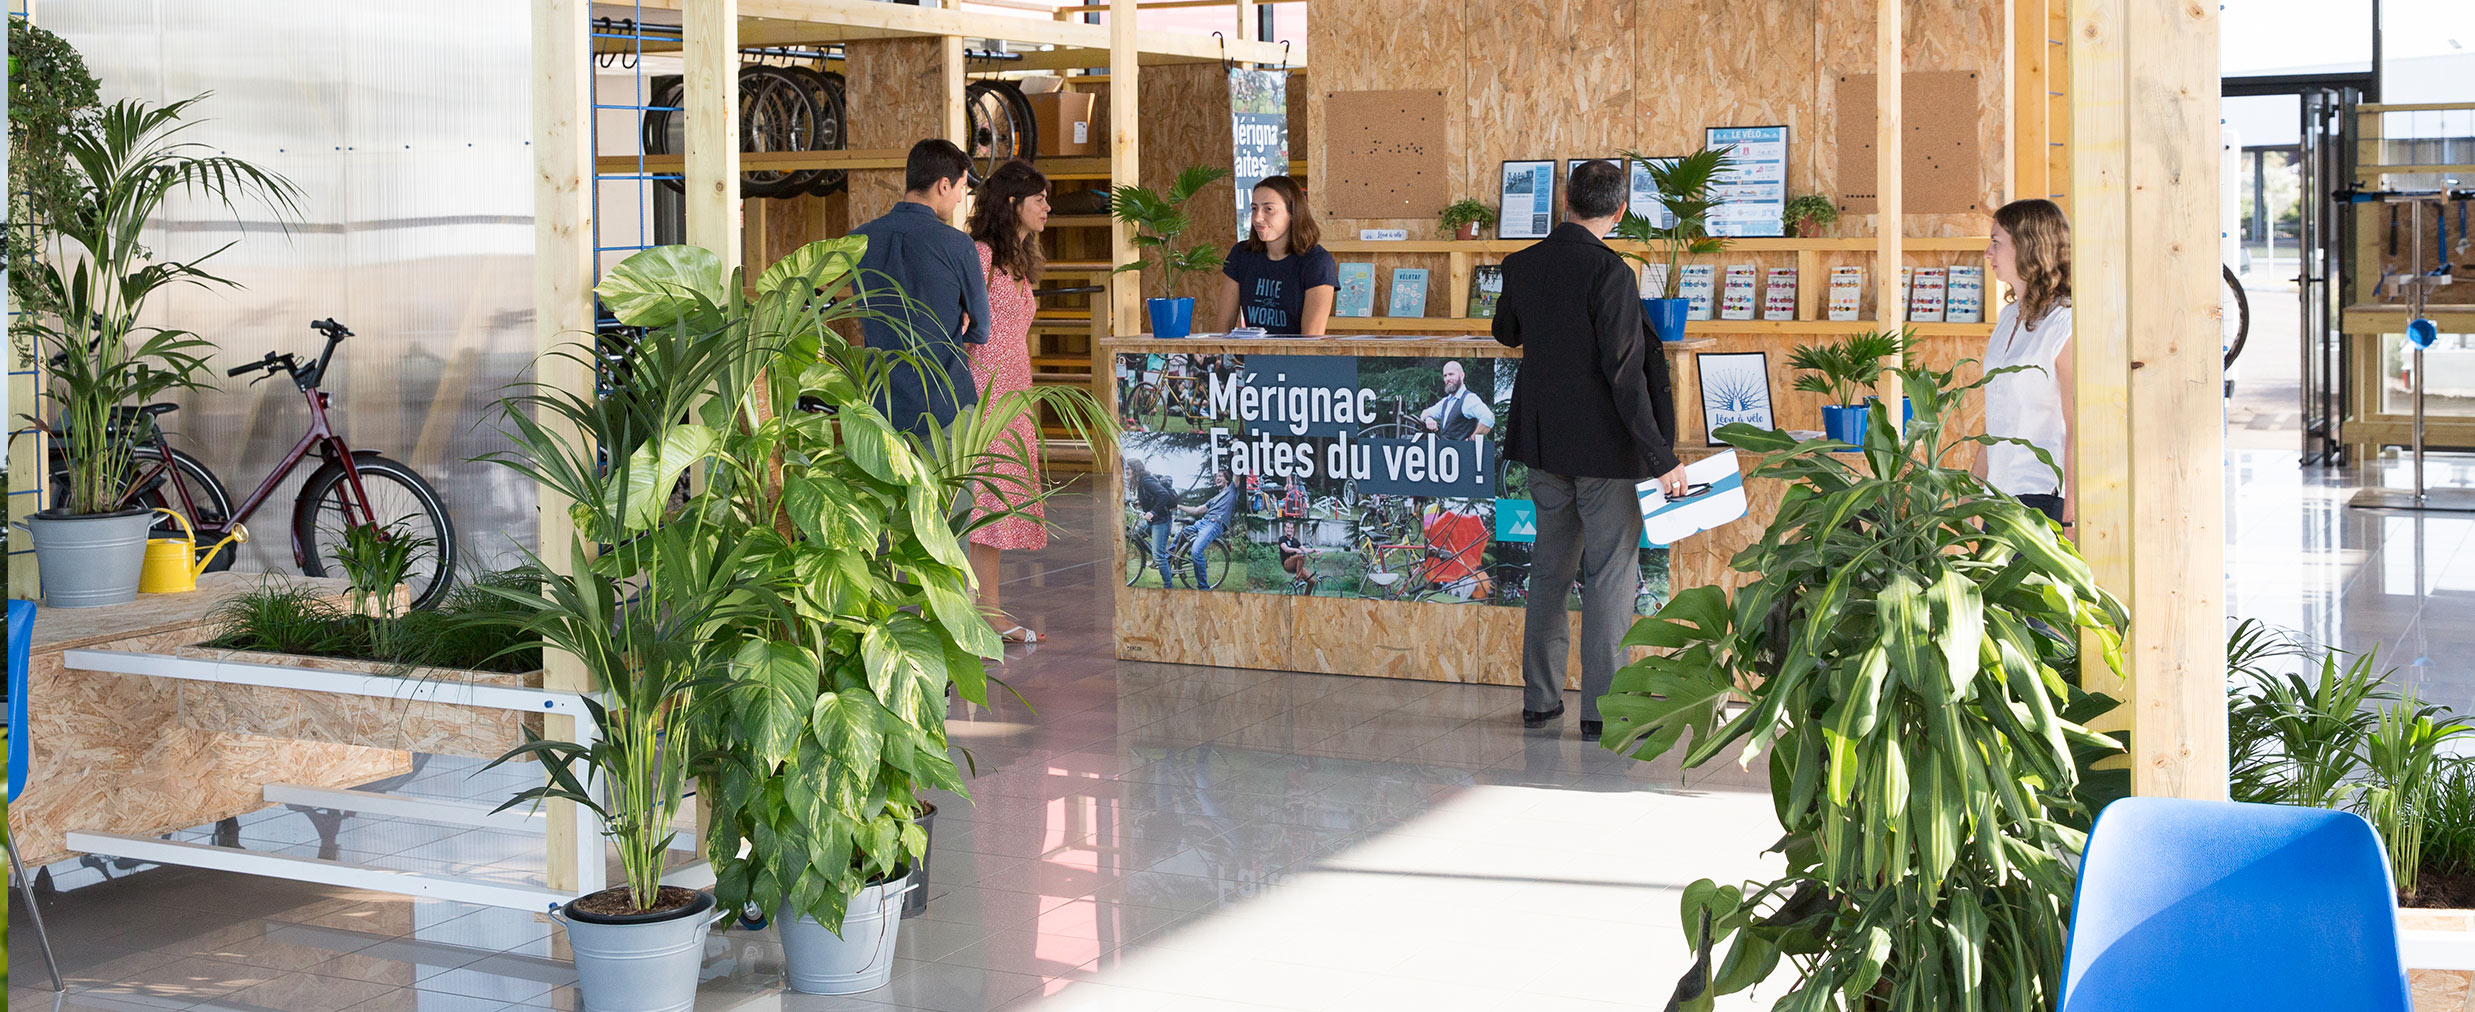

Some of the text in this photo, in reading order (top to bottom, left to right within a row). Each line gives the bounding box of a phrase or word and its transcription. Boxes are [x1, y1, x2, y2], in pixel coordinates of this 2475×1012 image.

[1731, 128, 1762, 139] LE VÉLO
[1235, 148, 1268, 178] aites
[1255, 278, 1282, 299] HIKE
[1247, 305, 1287, 327] WORLD
[1208, 372, 1377, 436] Mérignac
[1715, 413, 1734, 426] Léon
[1746, 412, 1764, 424] vélo
[1210, 427, 1485, 484] Faites du vélo !
